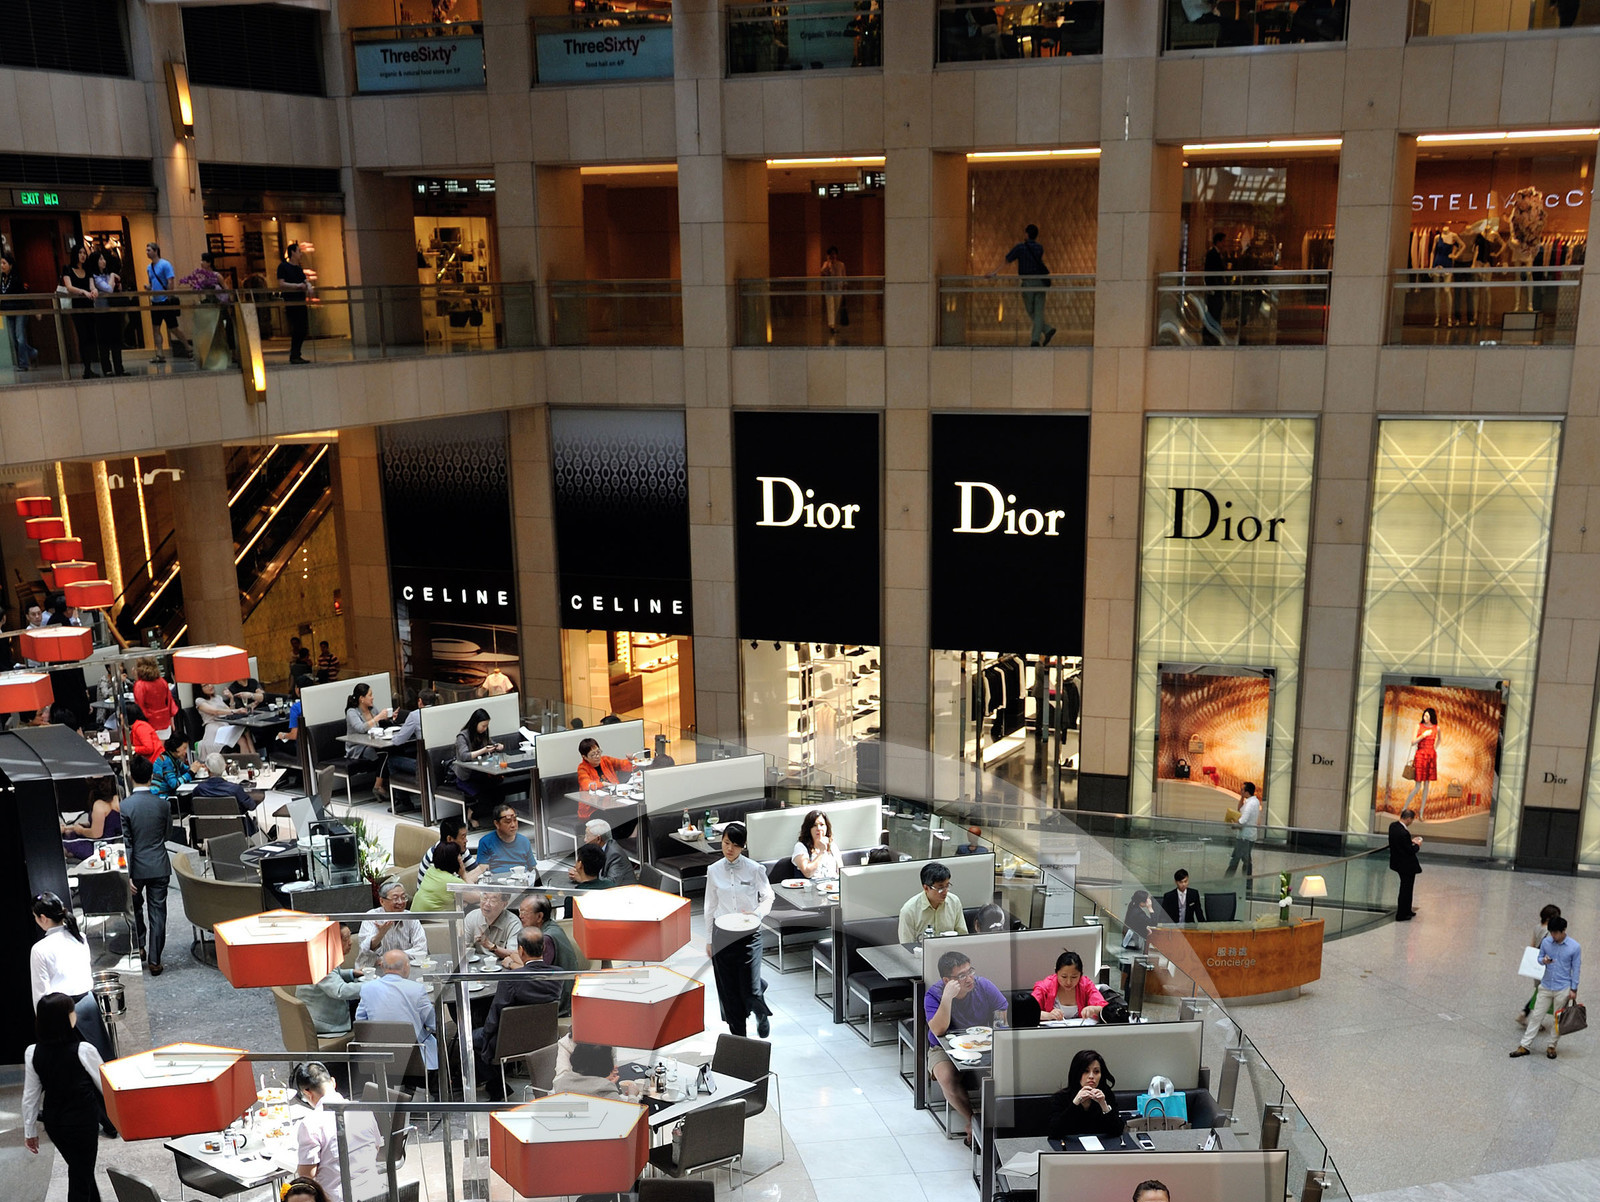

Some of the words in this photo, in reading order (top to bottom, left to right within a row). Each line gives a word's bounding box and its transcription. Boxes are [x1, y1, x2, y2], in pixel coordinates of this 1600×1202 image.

[20, 191, 40, 205] EXIT
[43, 191, 59, 205] 出口
[756, 476, 860, 529] Dior
[952, 481, 1066, 536] Dior
[1164, 487, 1286, 542] Dior
[403, 585, 508, 606] CELINE
[571, 595, 683, 615] CELINE
[1311, 754, 1334, 766] Dior
[1543, 772, 1568, 784] Dior
[1206, 957, 1256, 968] Concierge
